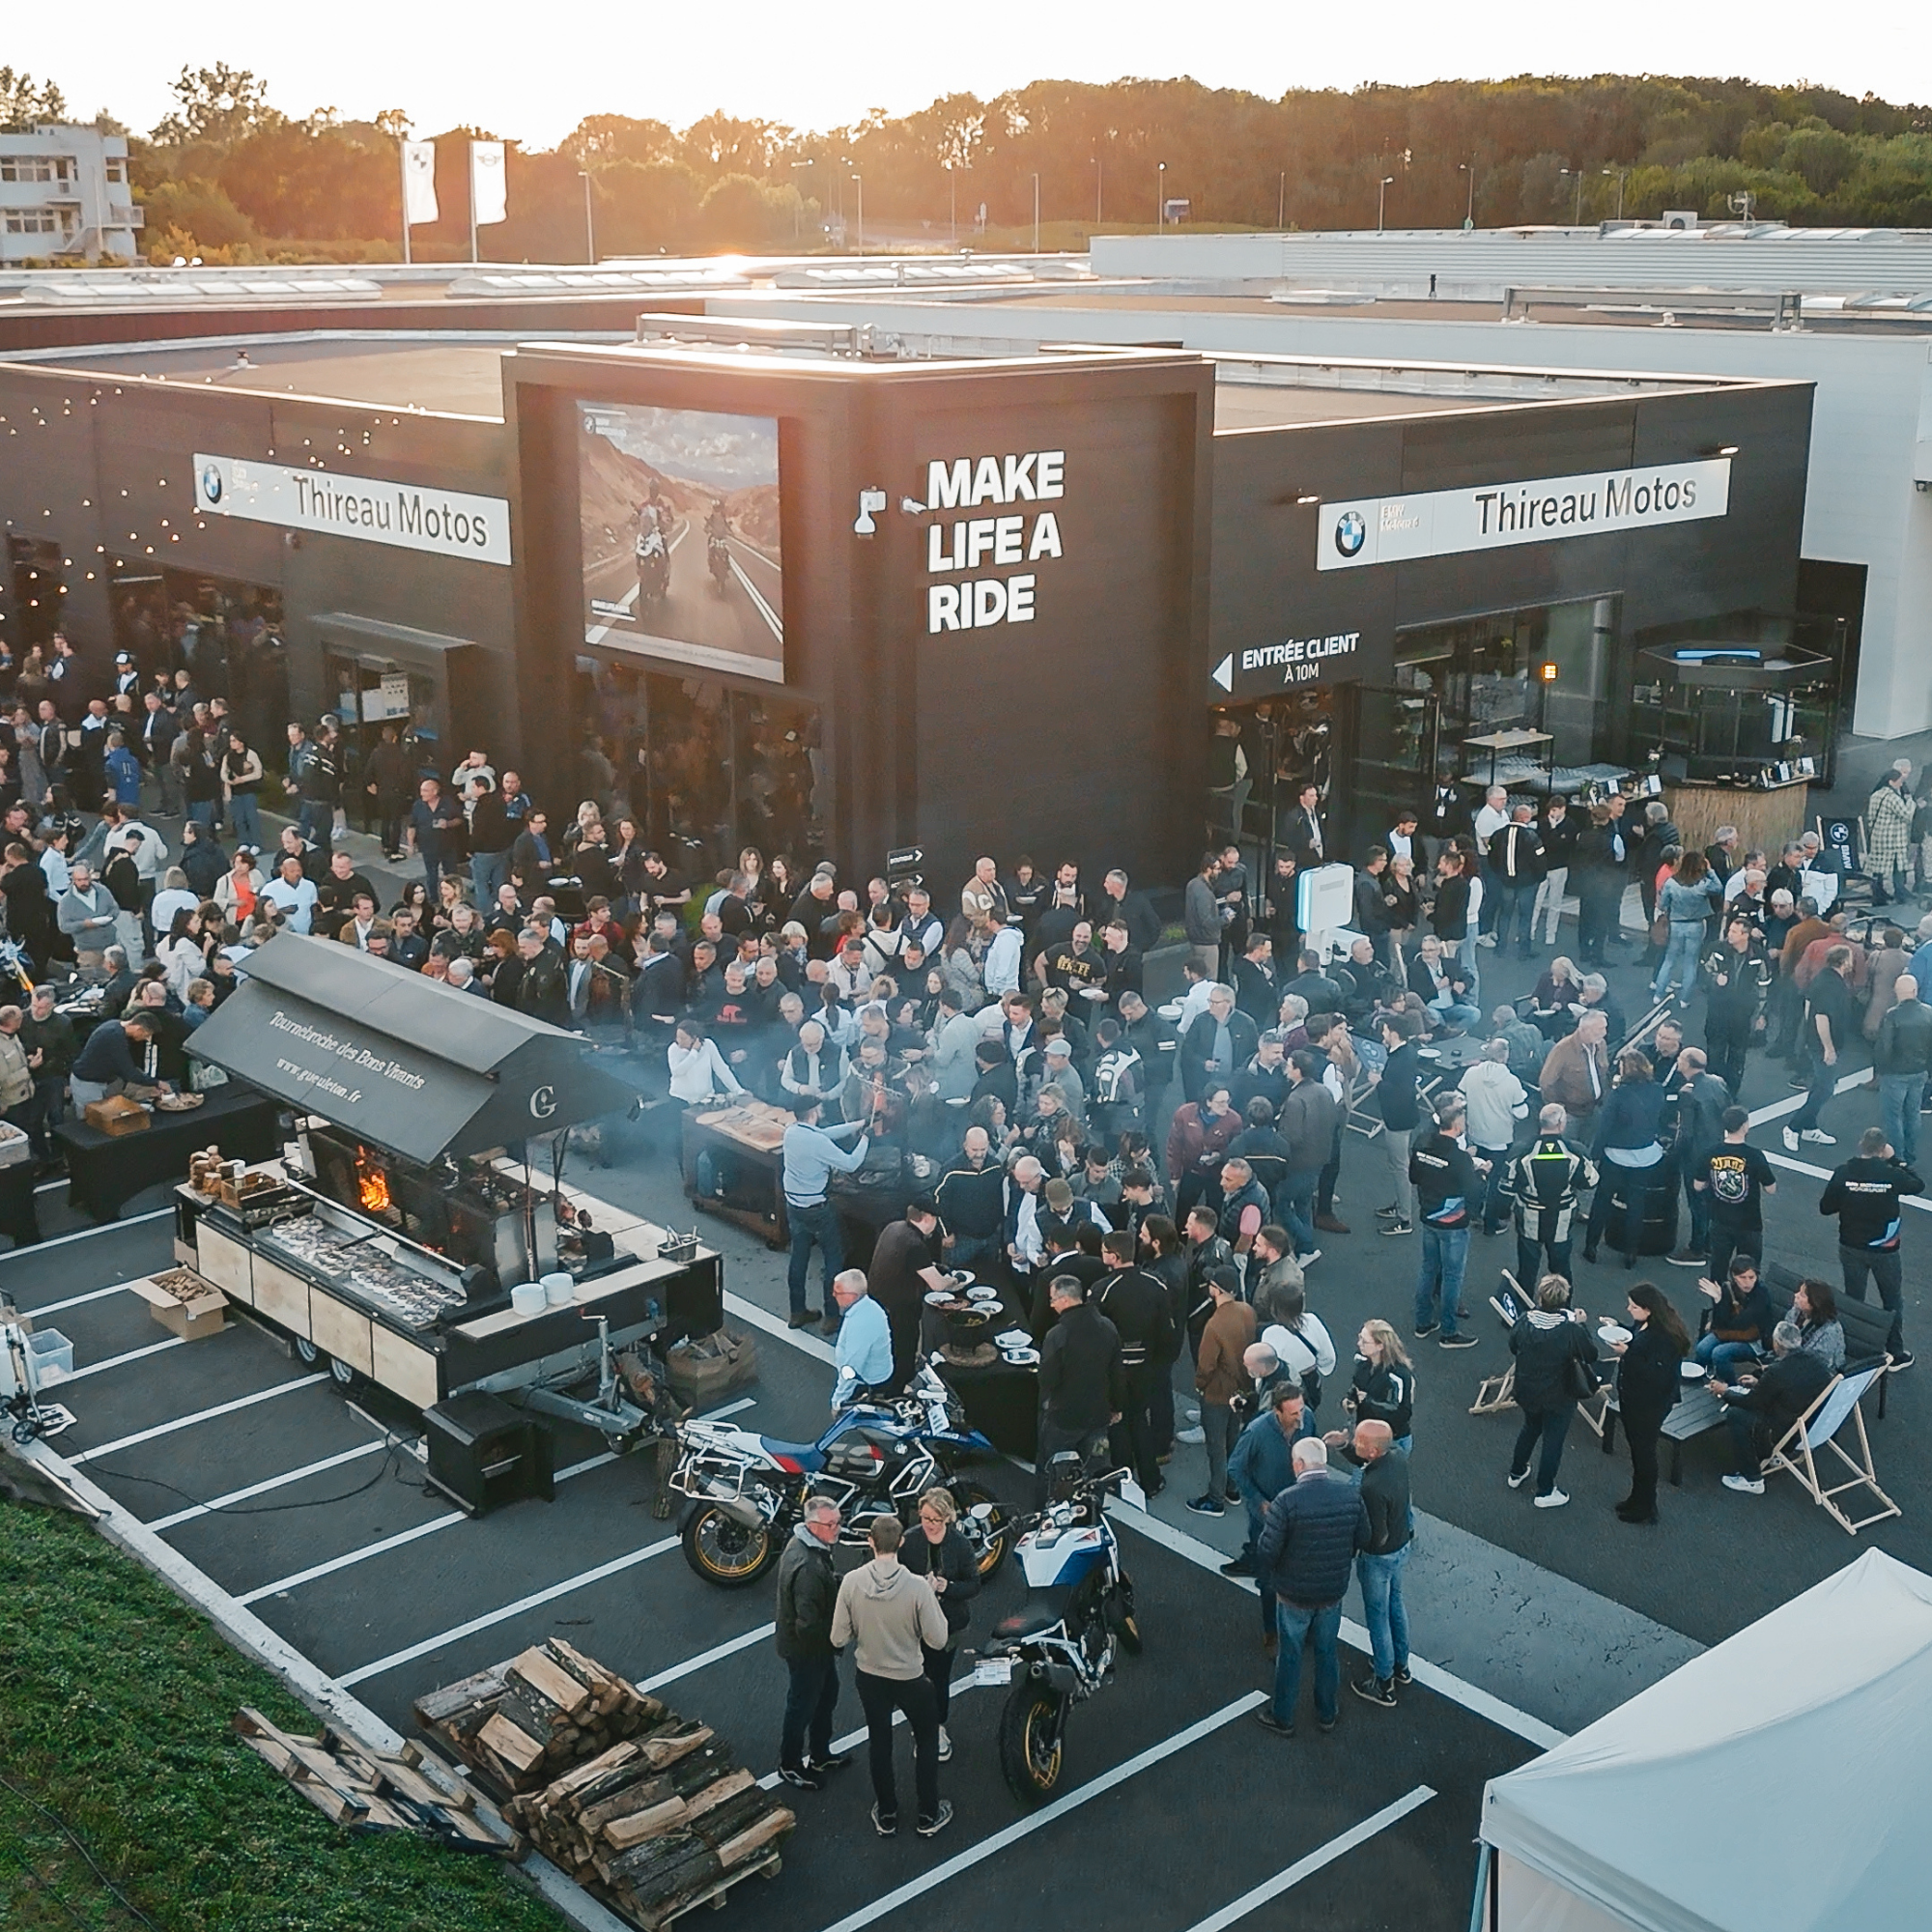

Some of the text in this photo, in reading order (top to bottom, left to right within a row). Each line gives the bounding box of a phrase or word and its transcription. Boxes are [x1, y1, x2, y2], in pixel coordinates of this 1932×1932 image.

[927, 450, 1065, 510] MAKE
[1475, 476, 1697, 535] Thireau Motos
[293, 474, 391, 531] Thireau
[398, 491, 488, 548] Motos
[927, 512, 1064, 573] LIFE A
[928, 574, 1036, 634] RIDE
[1242, 632, 1360, 670] ENTRÉE CLIENT
[1295, 662, 1321, 682] 10M
[270, 1010, 426, 1090] Tournebroche des Bons Vivants
[276, 1058, 363, 1103] www.gueuleton.fr
